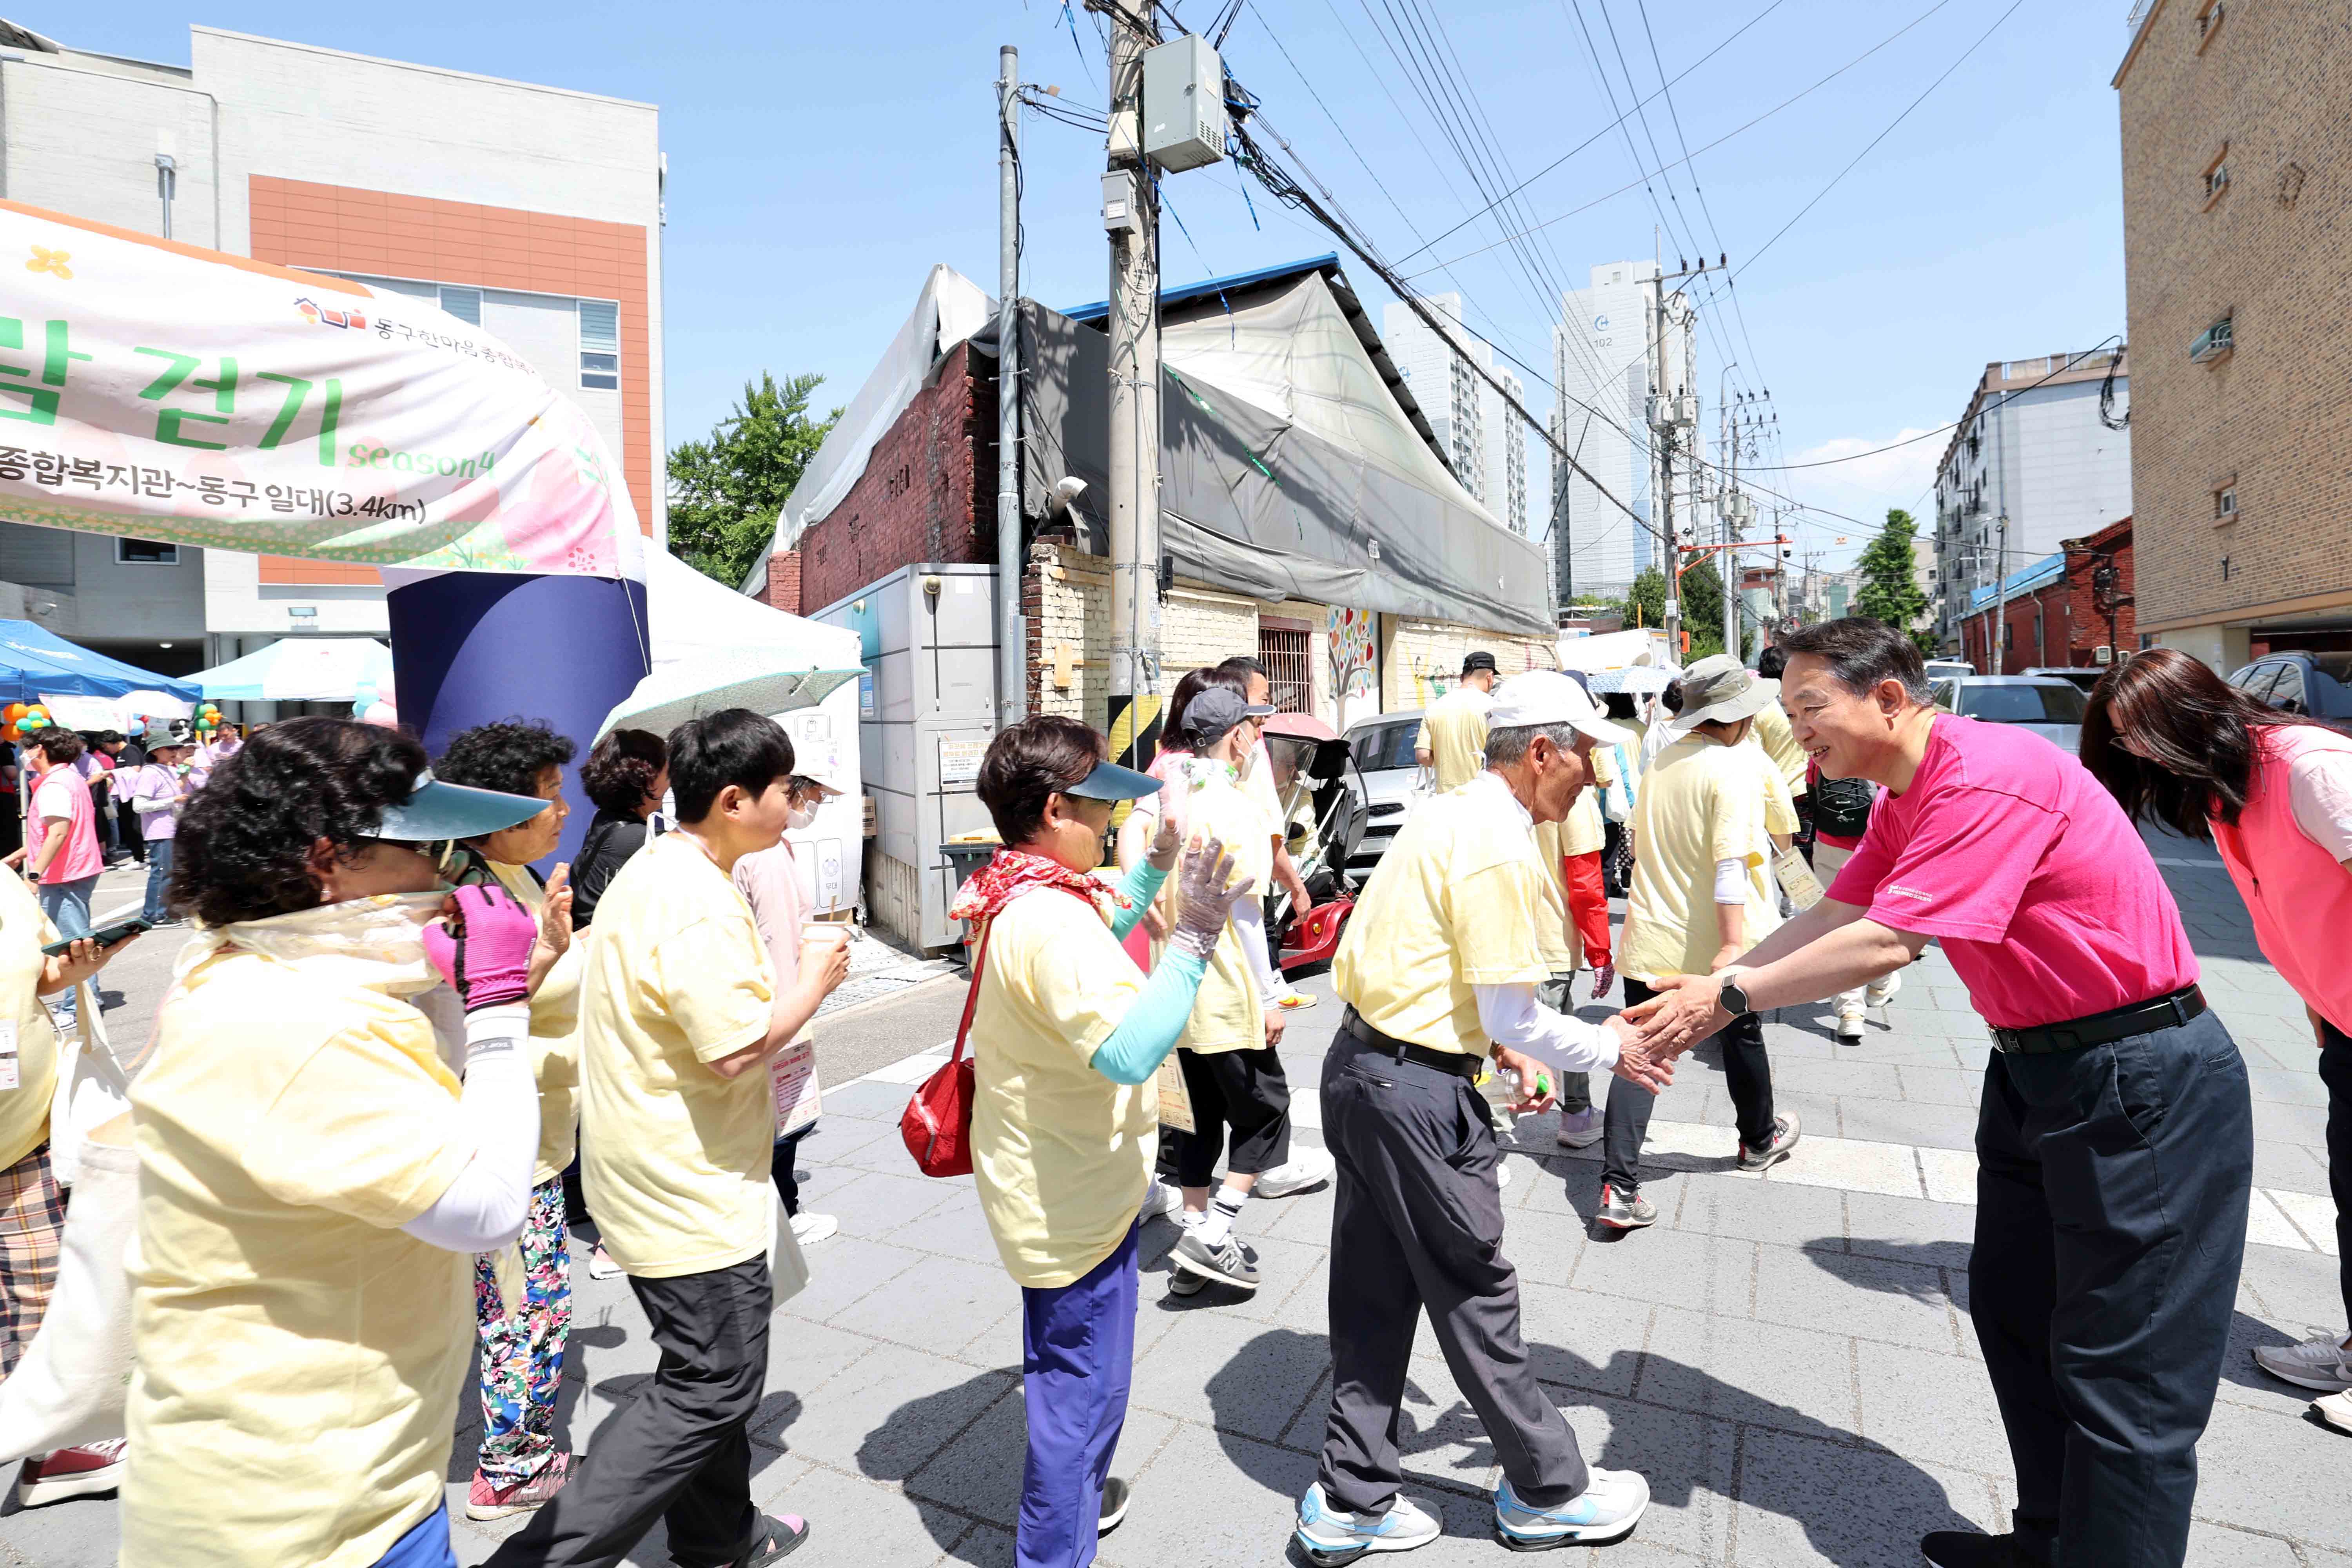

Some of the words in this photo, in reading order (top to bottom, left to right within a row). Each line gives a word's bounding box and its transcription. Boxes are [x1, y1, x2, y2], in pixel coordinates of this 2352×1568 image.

[1594, 338, 1612, 348] 102
[133, 346, 342, 467] 걷기
[265, 483, 426, 524] 일대(3.4km)
[1602, 586, 1621, 596] 102
